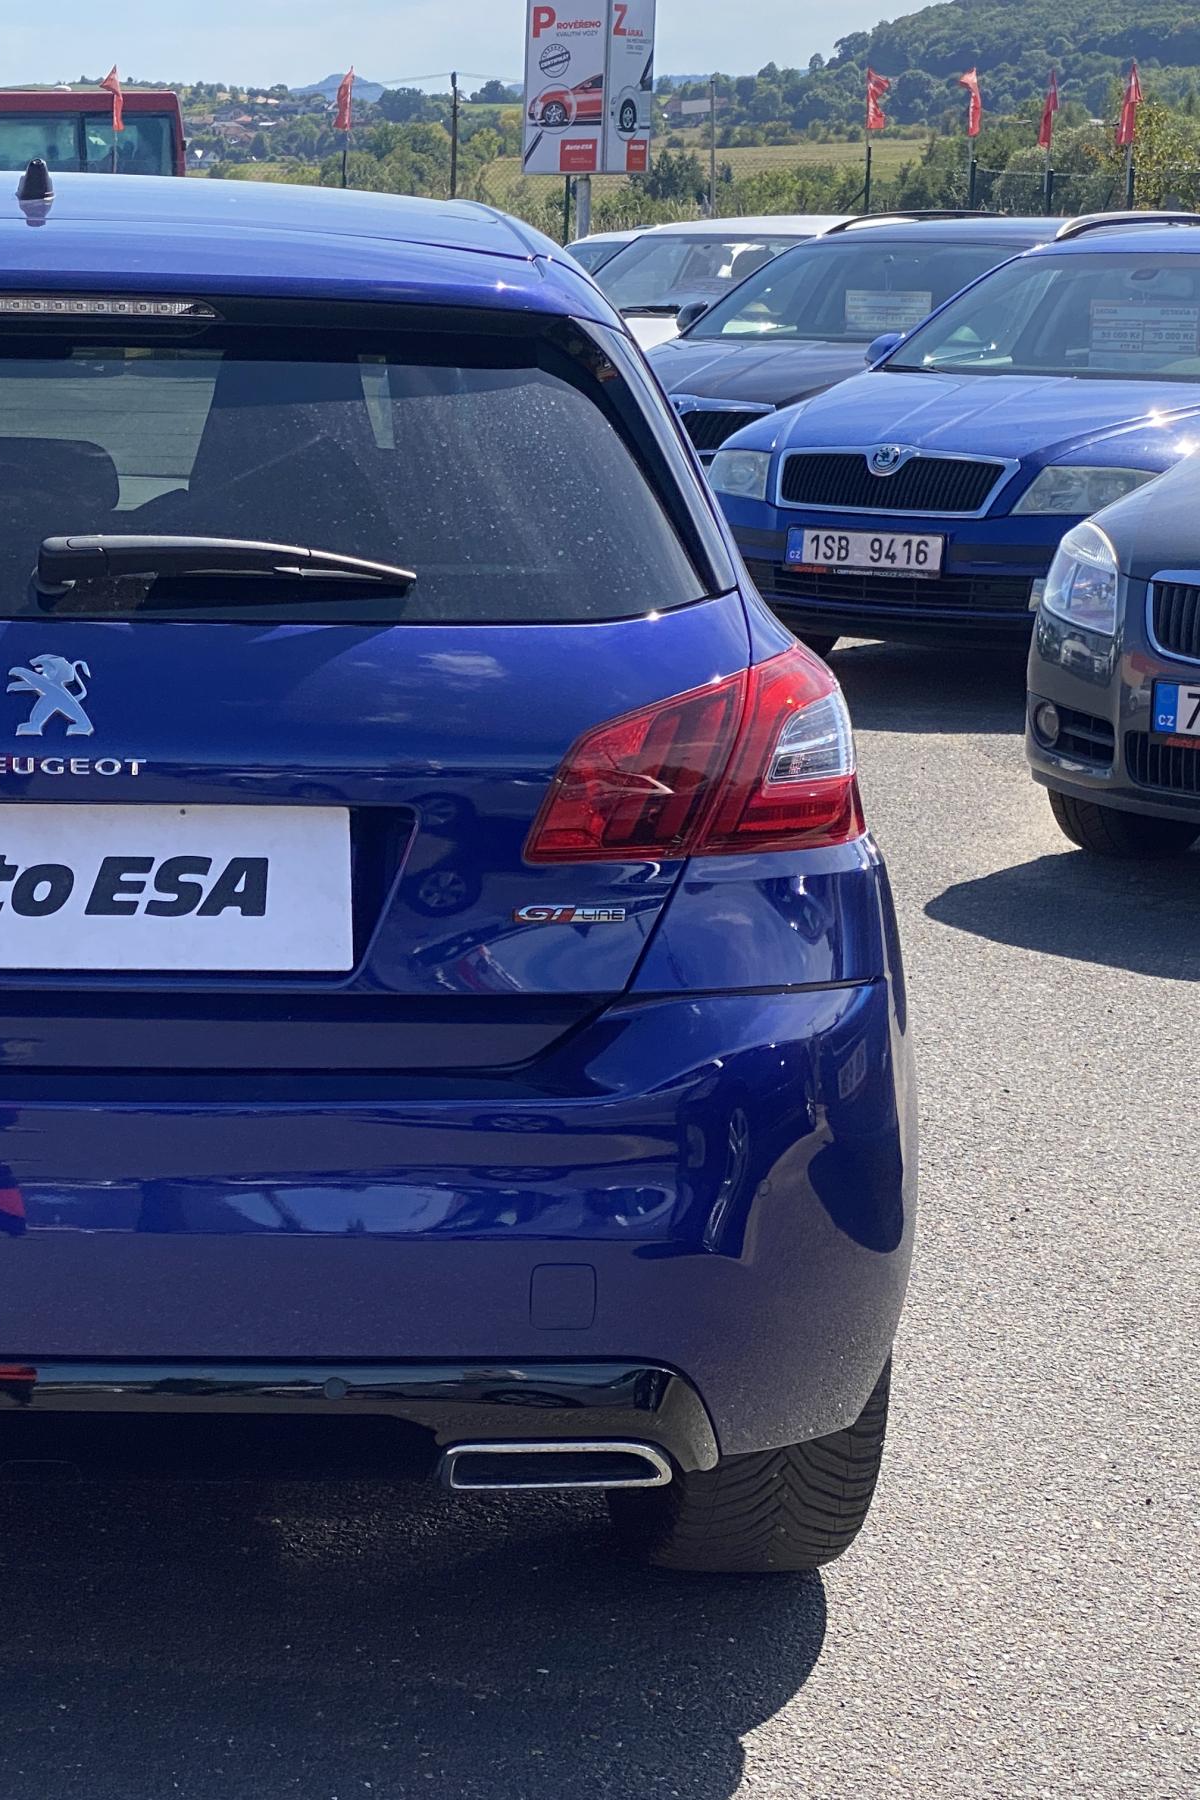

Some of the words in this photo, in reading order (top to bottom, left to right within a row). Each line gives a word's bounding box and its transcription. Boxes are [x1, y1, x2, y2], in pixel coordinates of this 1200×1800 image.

[789, 551, 801, 559] CZ
[810, 534, 850, 562] 1SB
[869, 537, 930, 565] 9416
[1158, 714, 1175, 727] CZ
[83, 854, 270, 917] ESA
[518, 904, 576, 920] GT
[581, 908, 624, 921] LINE
